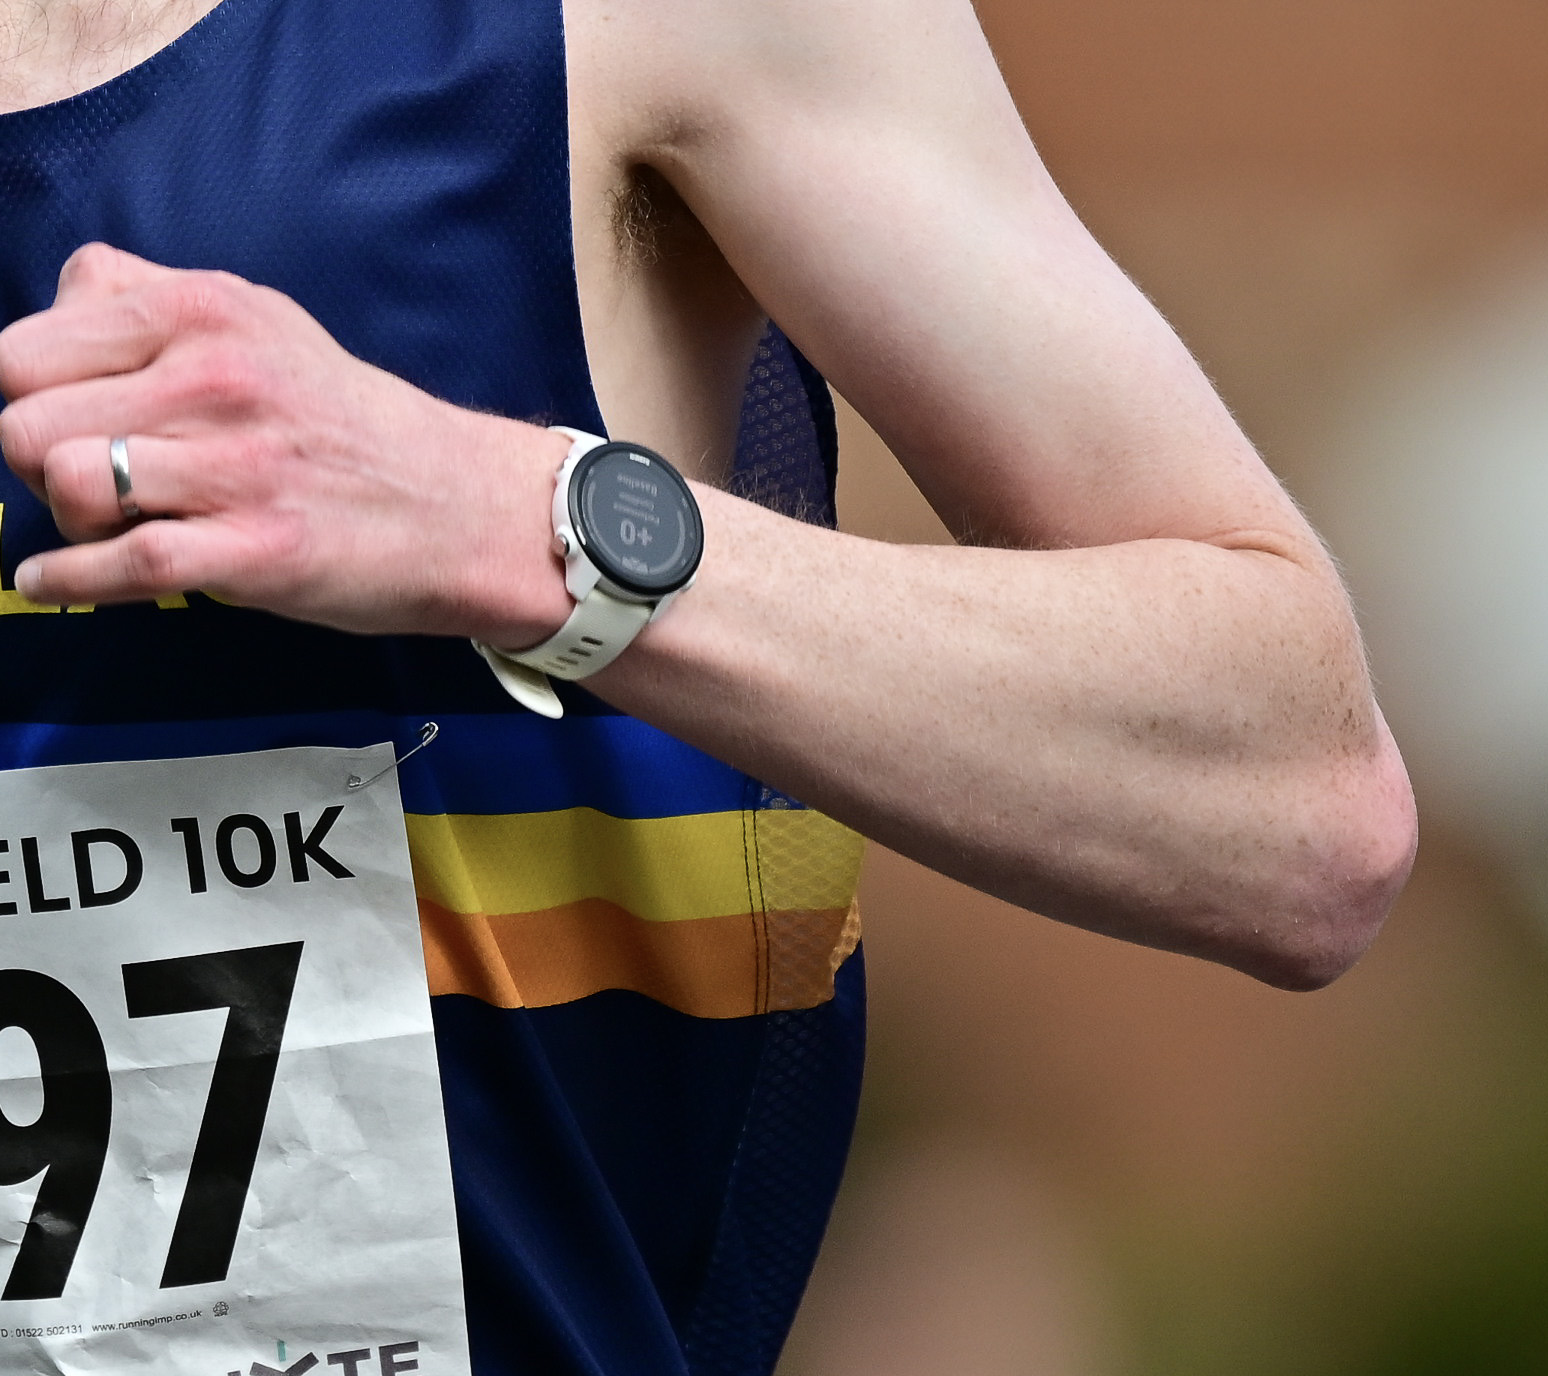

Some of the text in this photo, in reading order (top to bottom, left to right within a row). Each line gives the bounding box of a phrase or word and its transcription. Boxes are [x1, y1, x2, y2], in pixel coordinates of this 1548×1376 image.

[170, 804, 357, 894] 10K
[15, 1327, 43, 1338] 01522
[46, 1325, 83, 1336] 502131
[92, 1309, 203, 1332] www.runningimp.co.uk
